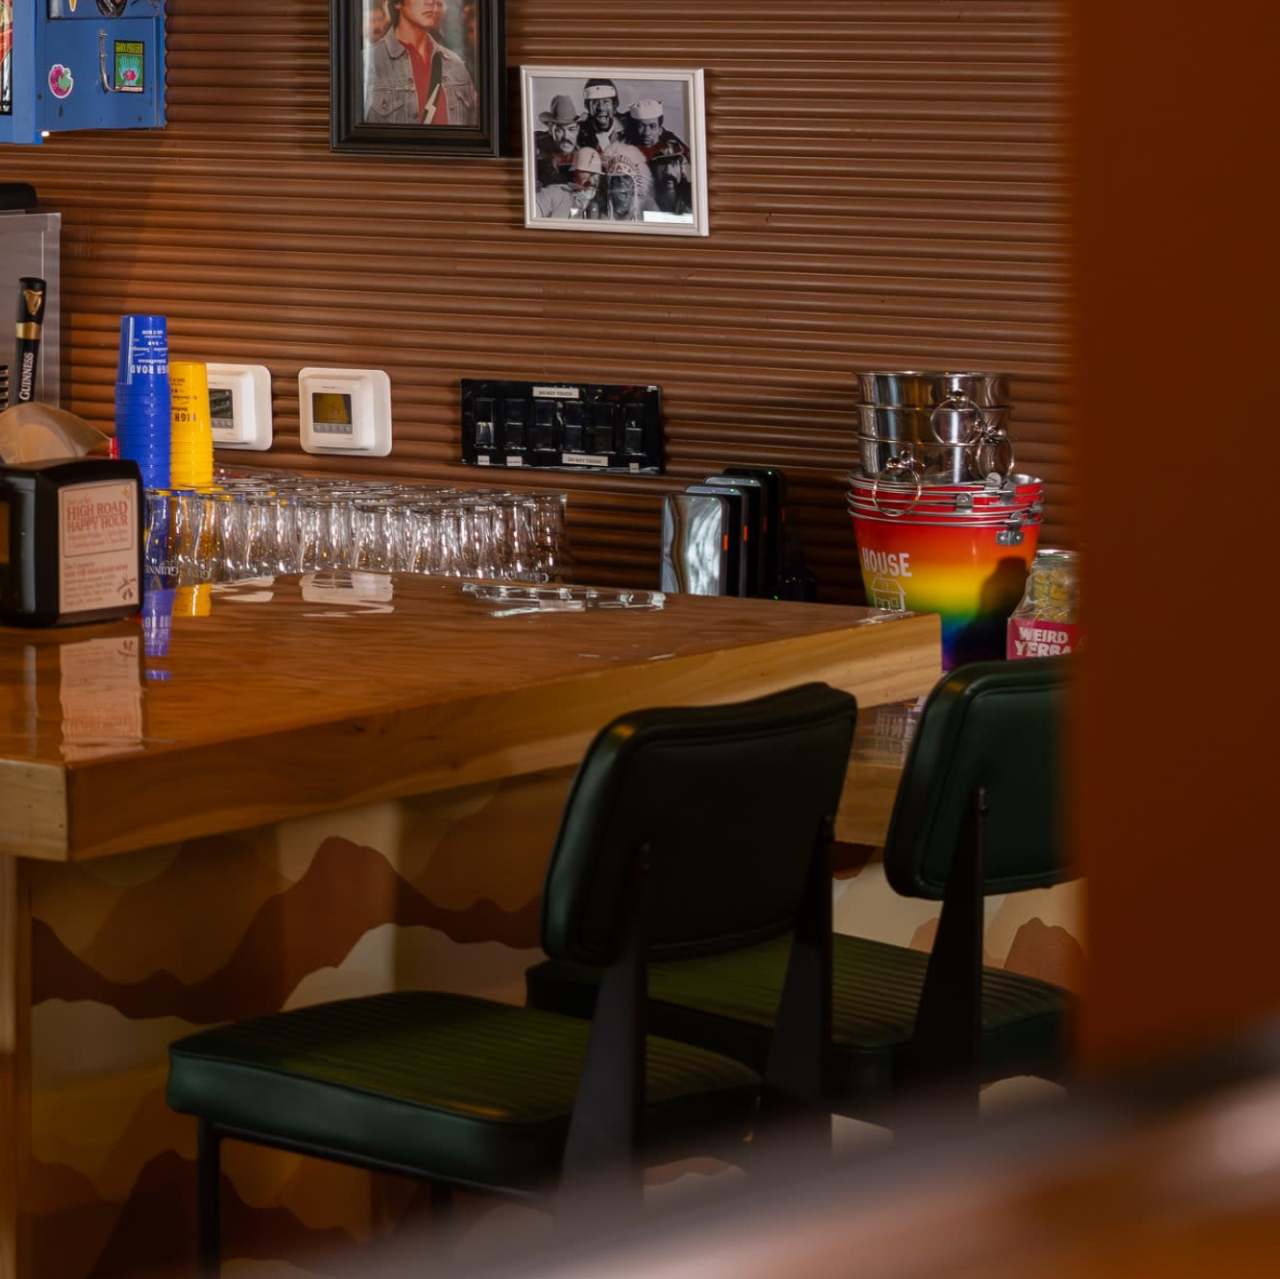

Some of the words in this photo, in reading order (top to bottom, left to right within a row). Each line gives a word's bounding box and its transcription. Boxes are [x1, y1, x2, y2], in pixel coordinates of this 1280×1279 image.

[19, 351, 35, 401] GUINNESS
[130, 364, 155, 375] ROAD
[66, 504, 95, 521] HIGH
[96, 501, 129, 516] ROAD
[67, 517, 100, 532] HAPPY
[101, 514, 129, 529] HOUR
[861, 549, 913, 579] HOUSE
[1017, 625, 1069, 645] WEIRD
